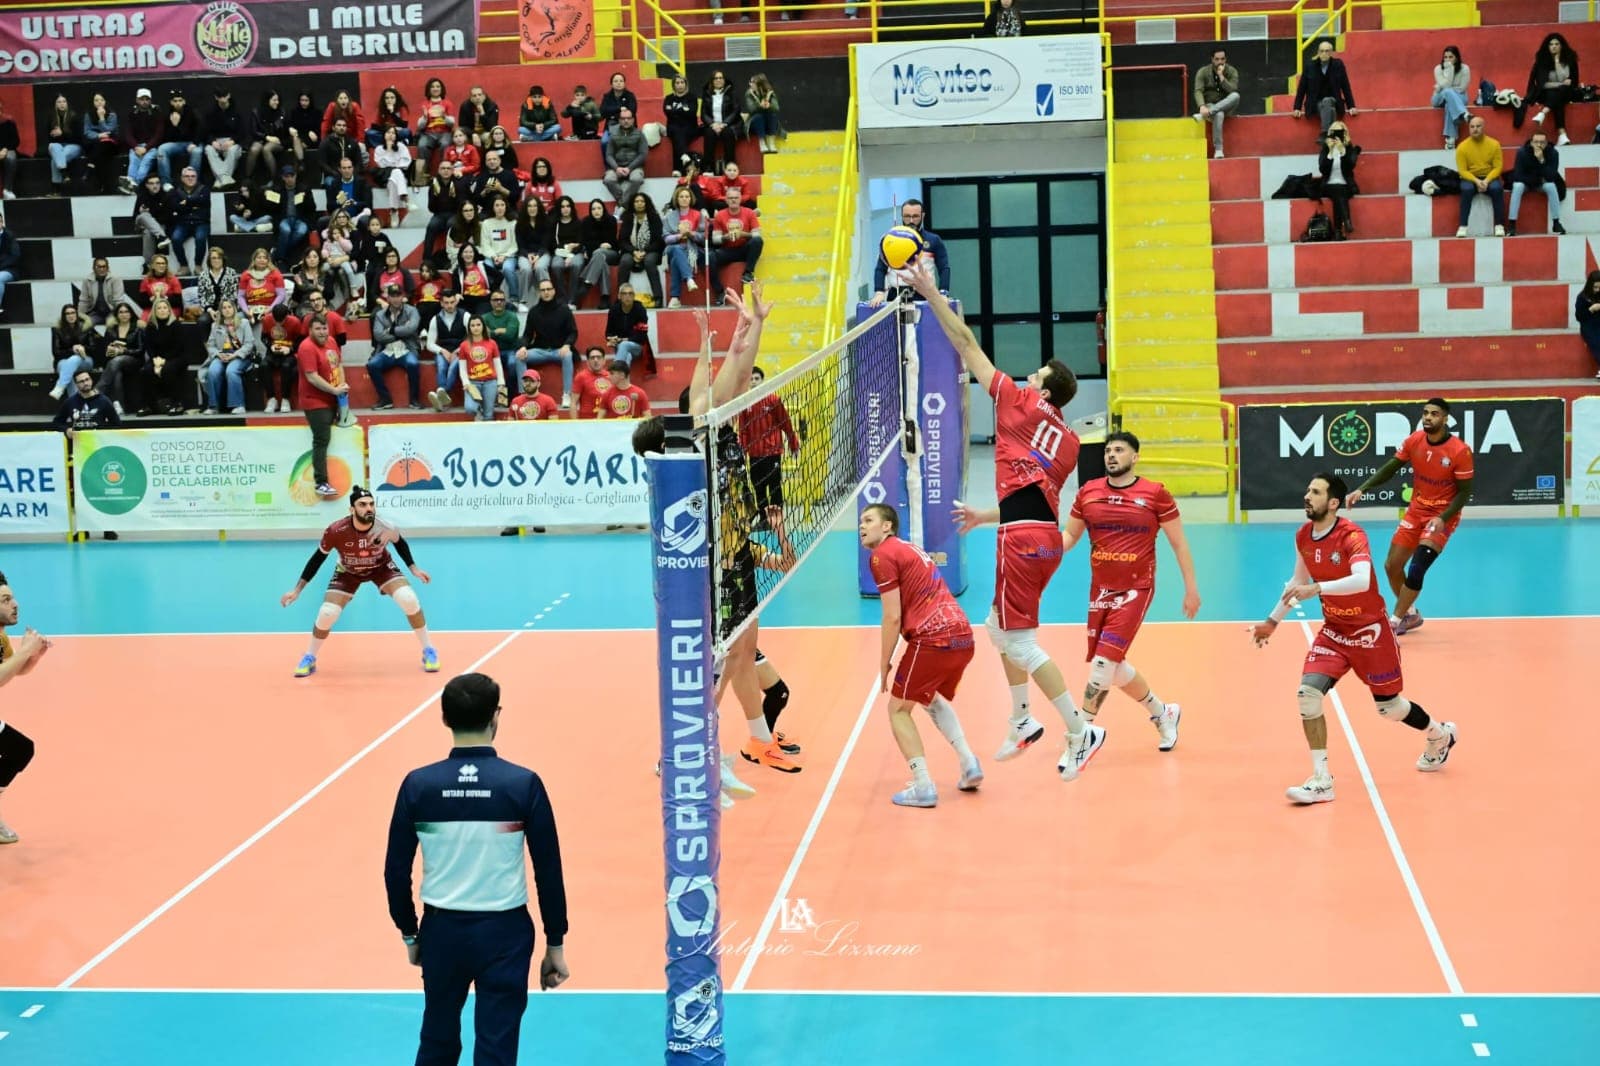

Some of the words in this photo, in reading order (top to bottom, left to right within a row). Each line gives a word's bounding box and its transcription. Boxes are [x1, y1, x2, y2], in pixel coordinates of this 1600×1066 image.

[309, 7, 320, 30] I
[331, 3, 424, 28] MILLE
[21, 12, 146, 40] ULTRAS
[269, 35, 330, 60] DEL
[341, 28, 466, 55] BRILLIA
[0, 44, 184, 74] CORIGLIANO
[893, 63, 993, 107] Movitec
[1059, 86, 1073, 96] ISO
[1075, 85, 1094, 96] 9001
[150, 440, 226, 453] CONSORZIO
[1030, 419, 1063, 461] 10
[151, 453, 174, 464] PER
[178, 453, 194, 464] LA
[198, 452, 245, 463] TUTELA
[927, 419, 941, 505] SPROVIERI
[1426, 451, 1432, 462] 7
[152, 465, 191, 476] DELLE
[195, 463, 277, 475] CLEMENTINE
[443, 446, 551, 489] BIOSY
[556, 444, 648, 487] BARI
[1335, 466, 1377, 477] morgia
[152, 477, 164, 487] DI
[168, 476, 231, 487] CALABRIA
[236, 476, 257, 488] IGP
[376, 497, 388, 508] Le
[390, 493, 448, 507] Clementine
[452, 494, 464, 507] da
[467, 492, 522, 510] agricoltura
[526, 492, 574, 507] Biologica
[586, 491, 641, 507] Corigliano
[1379, 490, 1395, 500] OP
[0, 502, 48, 517] ARM
[1315, 549, 1321, 563] 6
[671, 619, 708, 862] SPROVIERI
